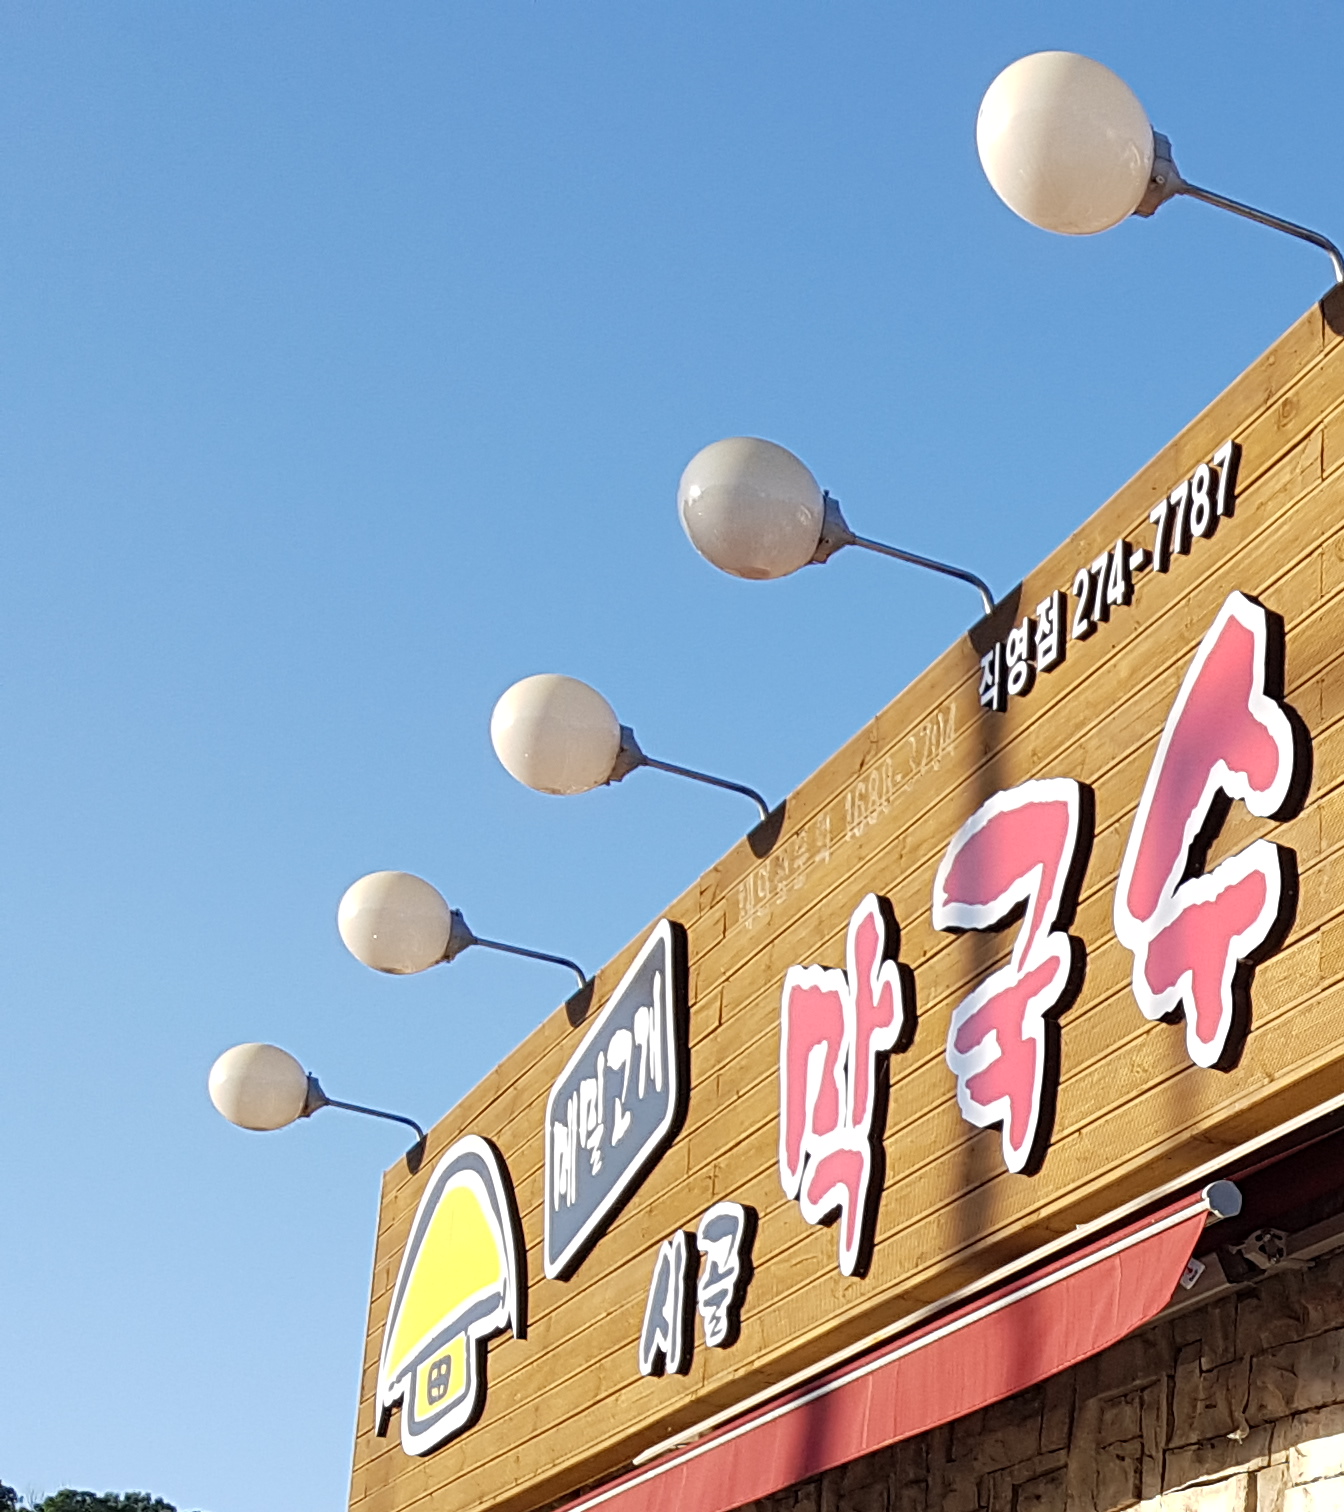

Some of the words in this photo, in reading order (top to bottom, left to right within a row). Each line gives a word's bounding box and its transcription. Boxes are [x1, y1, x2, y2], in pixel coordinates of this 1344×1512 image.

[980, 590, 1061, 711] 직영점
[1071, 439, 1238, 641] 274-7787
[552, 969, 664, 1213] 메밀고개
[638, 1200, 748, 1378] 시골
[780, 590, 1296, 1278] 막국수
